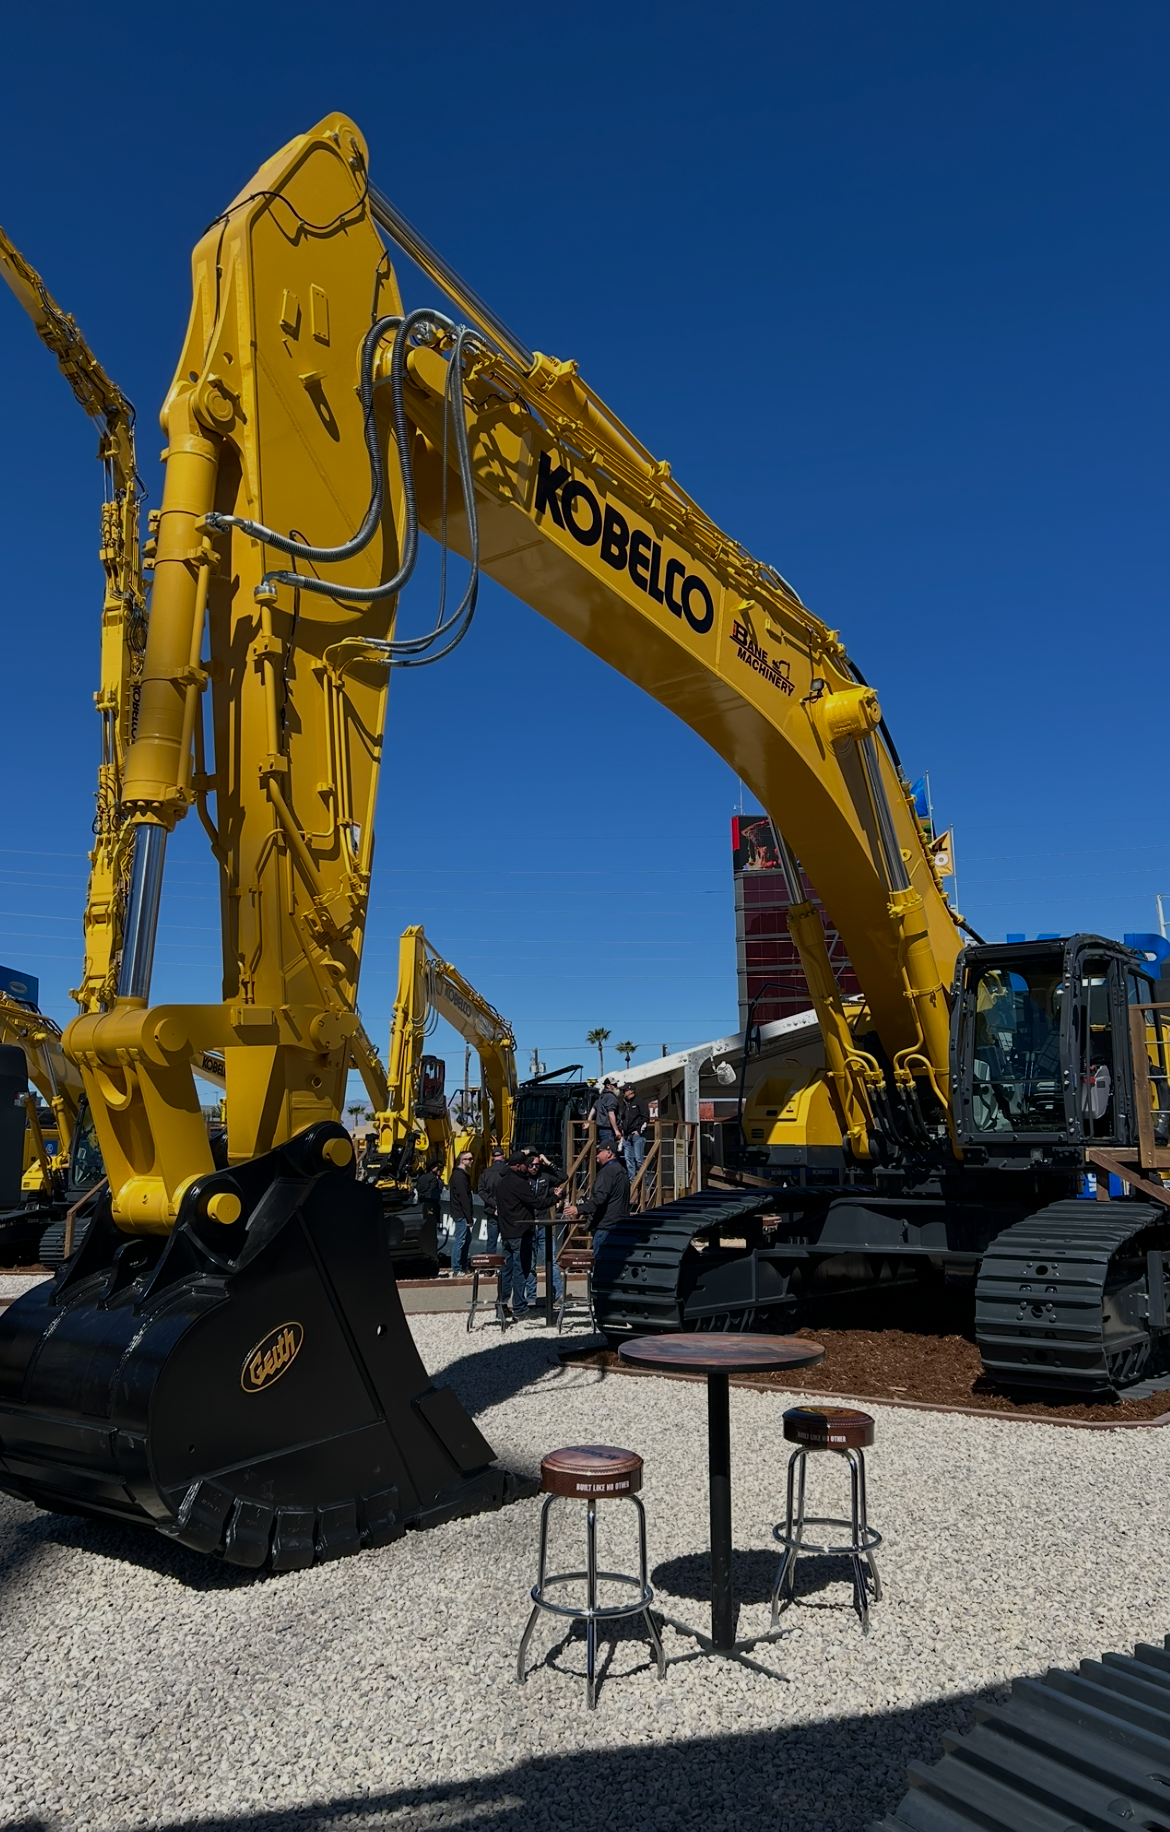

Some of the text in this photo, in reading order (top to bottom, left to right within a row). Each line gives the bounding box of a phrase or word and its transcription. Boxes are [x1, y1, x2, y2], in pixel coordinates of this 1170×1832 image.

[534, 450, 714, 634] KOBELCO
[732, 619, 768, 663] BANE
[737, 647, 794, 697] MACHINERY
[444, 985, 472, 1018] KOBELCO
